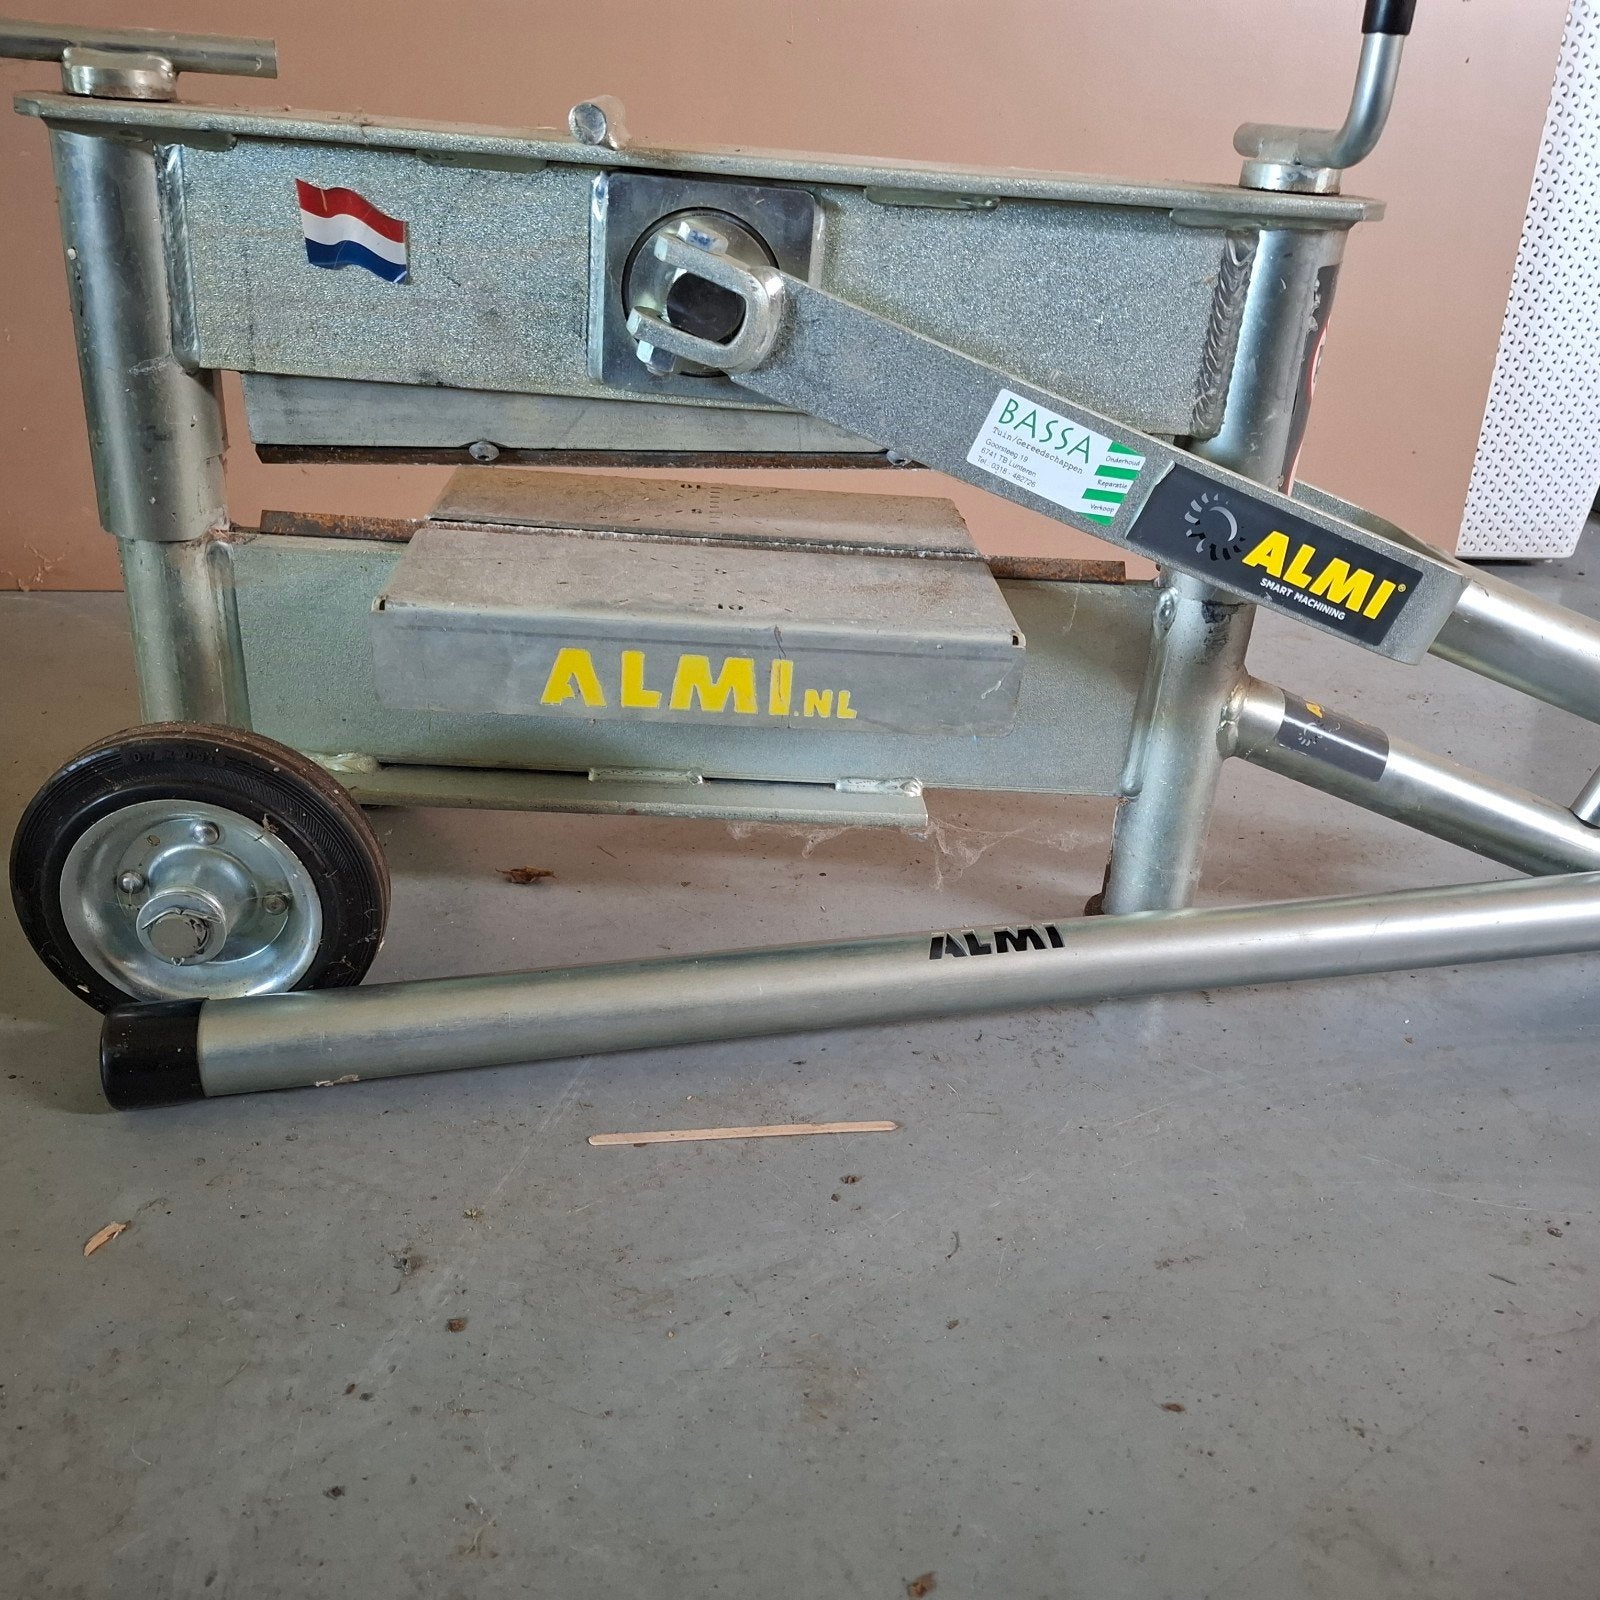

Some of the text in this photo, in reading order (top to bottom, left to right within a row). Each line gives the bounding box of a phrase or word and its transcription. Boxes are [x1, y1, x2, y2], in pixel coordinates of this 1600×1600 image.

[998, 397, 1091, 464] BASSA
[981, 447, 997, 459] 6741
[999, 455, 1009, 464] TB
[985, 438, 1029, 463] Goorsteeg 19
[992, 426, 1083, 475] Tuin/Gereedschappen
[1105, 455, 1141, 467] Onderhoud
[1097, 479, 1128, 490] Reparatie
[1090, 503, 1115, 513] Verkoop
[1259, 577, 1346, 621] SMART MACHINING
[929, 923, 1065, 961] ALMI
